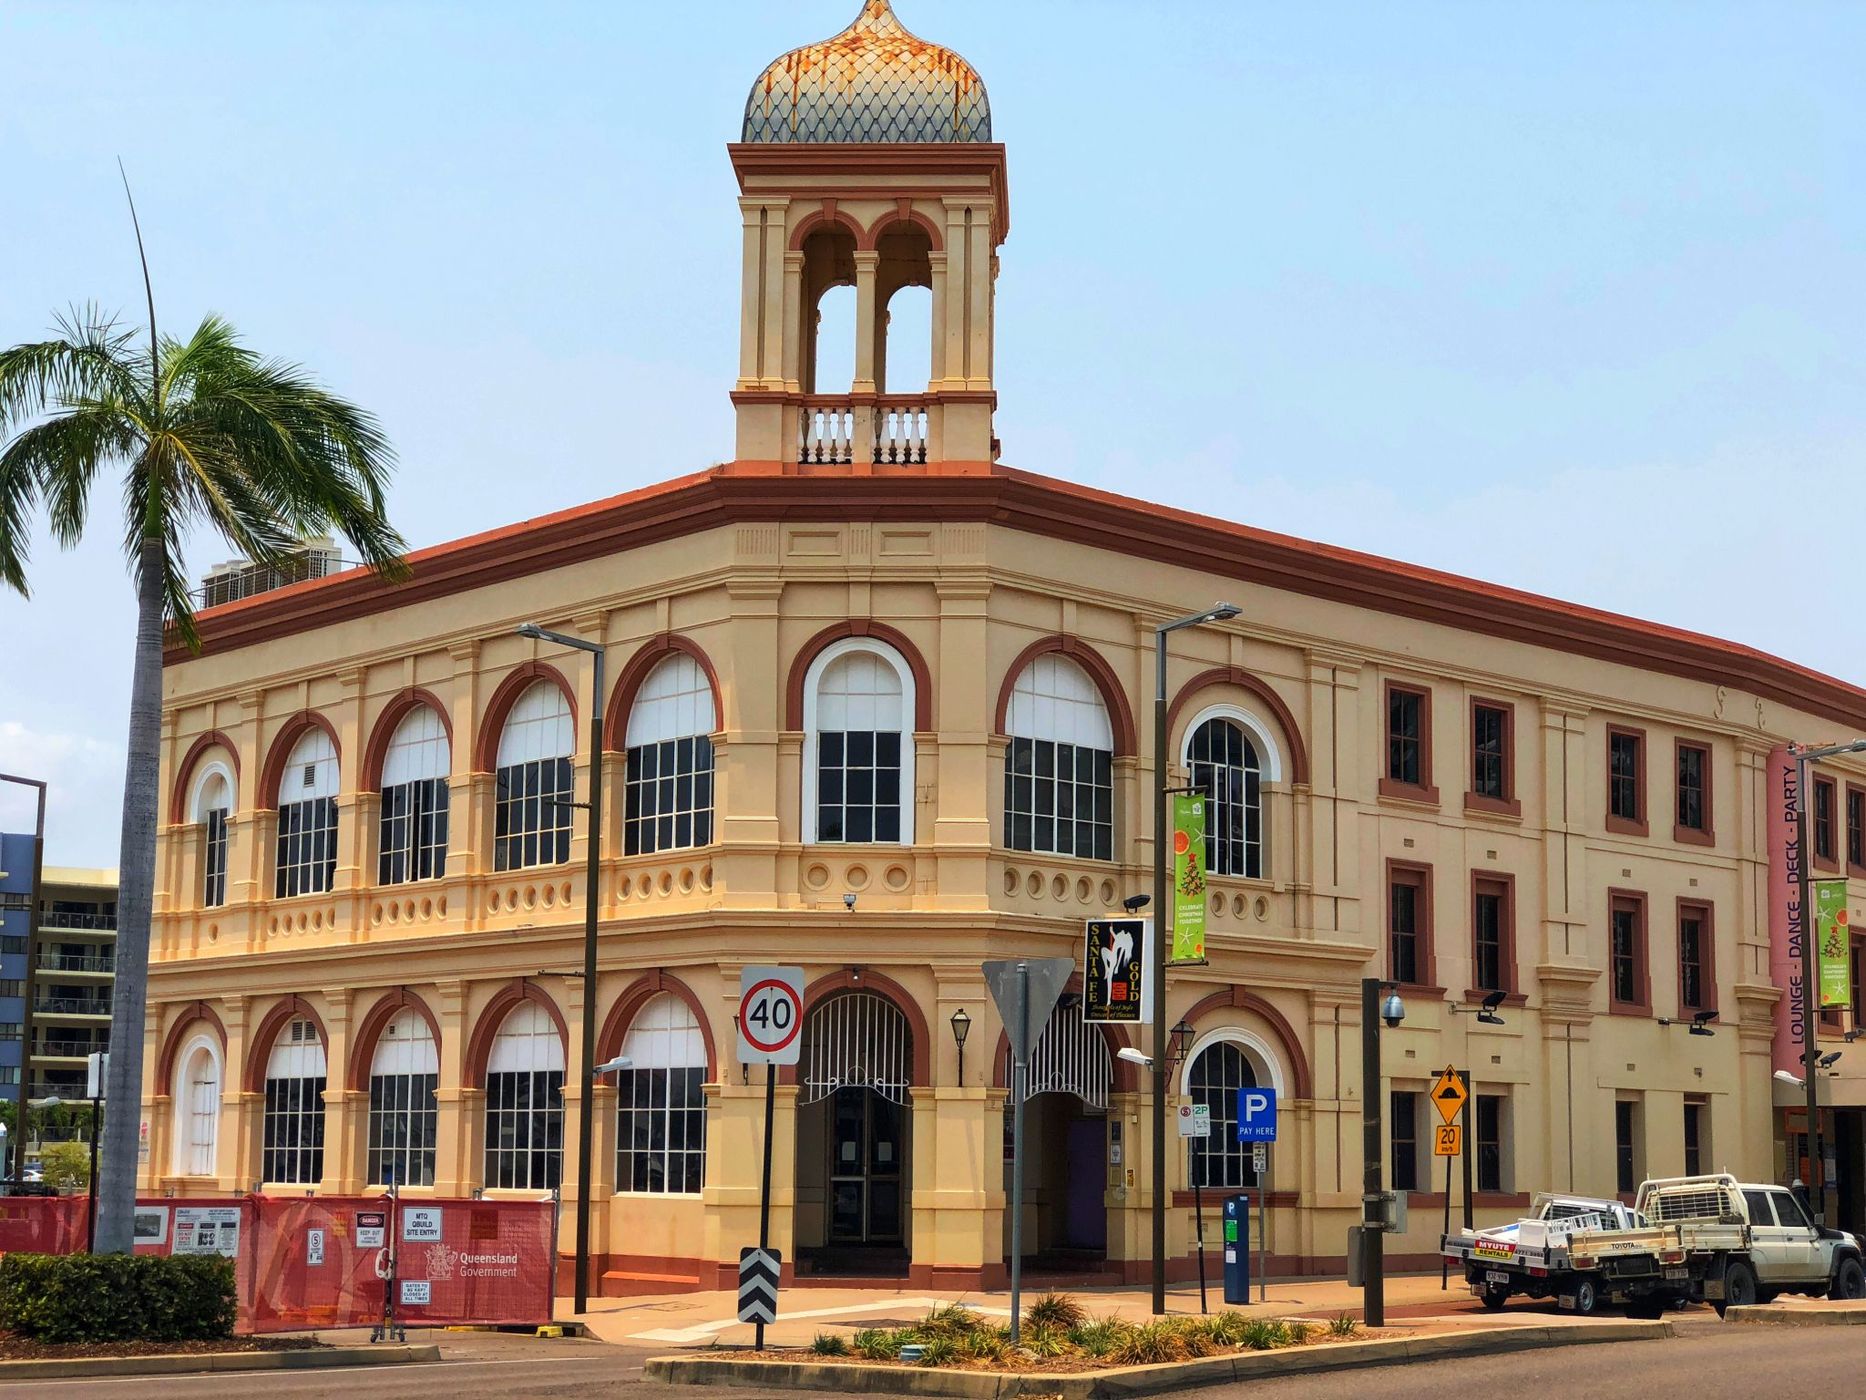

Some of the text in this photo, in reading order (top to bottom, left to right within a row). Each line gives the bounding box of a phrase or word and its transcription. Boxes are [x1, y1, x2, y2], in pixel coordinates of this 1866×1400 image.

[1783, 766, 1798, 822] PARTY
[1786, 840, 1799, 884] DECK
[1788, 901, 1801, 958] DANCE
[1088, 925, 1099, 1002] SANTA FE
[1129, 961, 1139, 1001] GOLD
[749, 998, 791, 1030] 40
[1791, 975, 1804, 1045] LOUNGE
[1195, 1106, 1208, 1115] 2P
[1246, 1094, 1267, 1122] P
[1240, 1127, 1275, 1135] PAY HERE
[1441, 1129, 1456, 1144] 20
[1228, 1202, 1235, 1213] P
[1479, 1241, 1510, 1251] MYUTE
[1479, 1249, 1508, 1258] RENTALS
[460, 1252, 518, 1265] Queensland
[460, 1266, 517, 1277] Government
